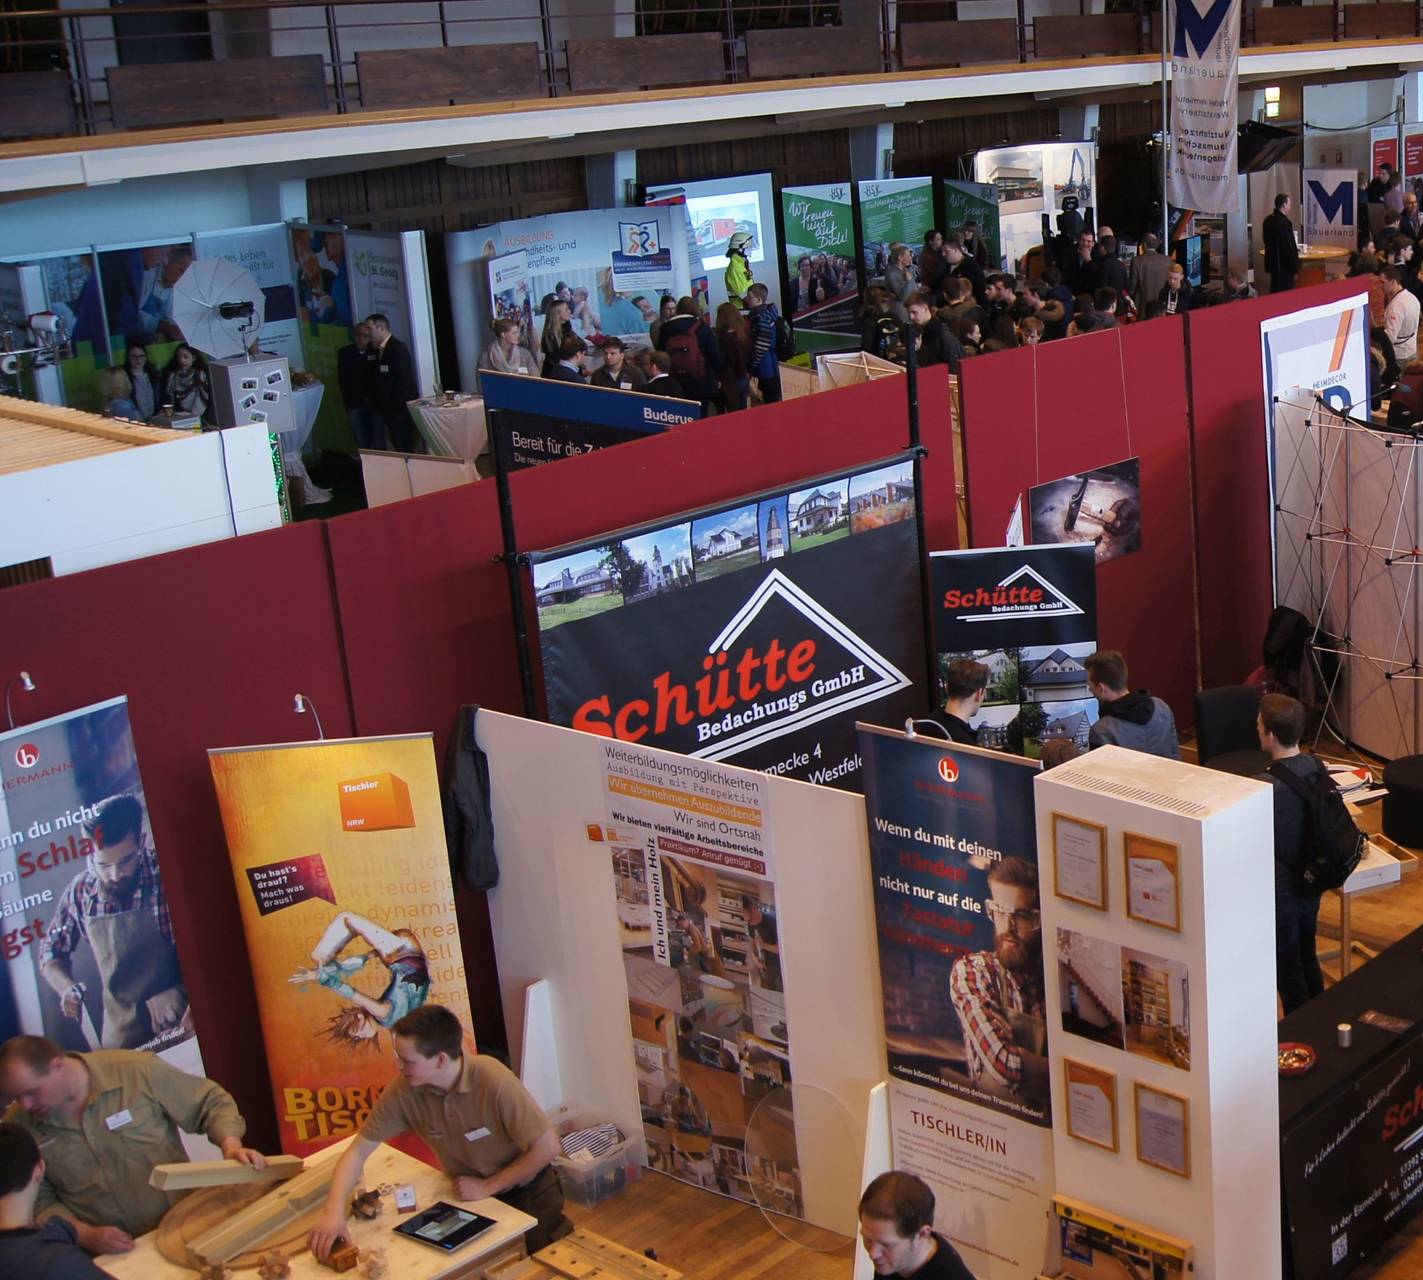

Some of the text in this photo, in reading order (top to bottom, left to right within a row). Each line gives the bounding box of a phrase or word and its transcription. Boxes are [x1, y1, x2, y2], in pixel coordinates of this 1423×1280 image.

[789, 202, 811, 217] Wir
[817, 229, 848, 249] Dich!
[1307, 228, 1354, 238] Sauerland
[558, 240, 577, 251] und
[512, 431, 544, 449] Bereit
[547, 436, 562, 454] für
[565, 442, 582, 456] die
[944, 585, 1044, 609] Schütte
[992, 601, 1064, 613] Bedachungs GmbH
[572, 639, 817, 743] Schütte
[697, 664, 867, 743] Bedachungs GmbH
[812, 743, 823, 758] 4
[605, 746, 759, 792] Weiterbildungsmöglichkeiten
[342, 780, 379, 793] Tischler
[606, 763, 759, 806] Ausbildung mit Perspektive
[608, 777, 762, 823] Wir übernehmen Auszubildende
[28, 819, 51, 840] du
[55, 803, 100, 829] nicht
[347, 818, 364, 828] NRW
[673, 810, 762, 842] Wir sind Ortsnah
[611, 811, 765, 857] Wir bieten vielfältige Arbeitsbereiche
[875, 817, 1002, 861] Wenn du mit deinen
[17, 824, 105, 878] Schlaf
[659, 838, 700, 855] Praktikum?
[254, 865, 297, 881] Du hast's
[900, 850, 968, 883] Händen
[257, 876, 288, 889] drauf?
[260, 884, 304, 900] Mach was
[263, 895, 294, 908] draus!
[647, 837, 667, 960] Ich und mein Holz
[879, 876, 982, 914] nicht nur auf die
[910, 1110, 1007, 1156] TISCHLER/IN
[1403, 1169, 1423, 1191] 02975
[1330, 1223, 1339, 1236] In
[1340, 1213, 1353, 1227] der
